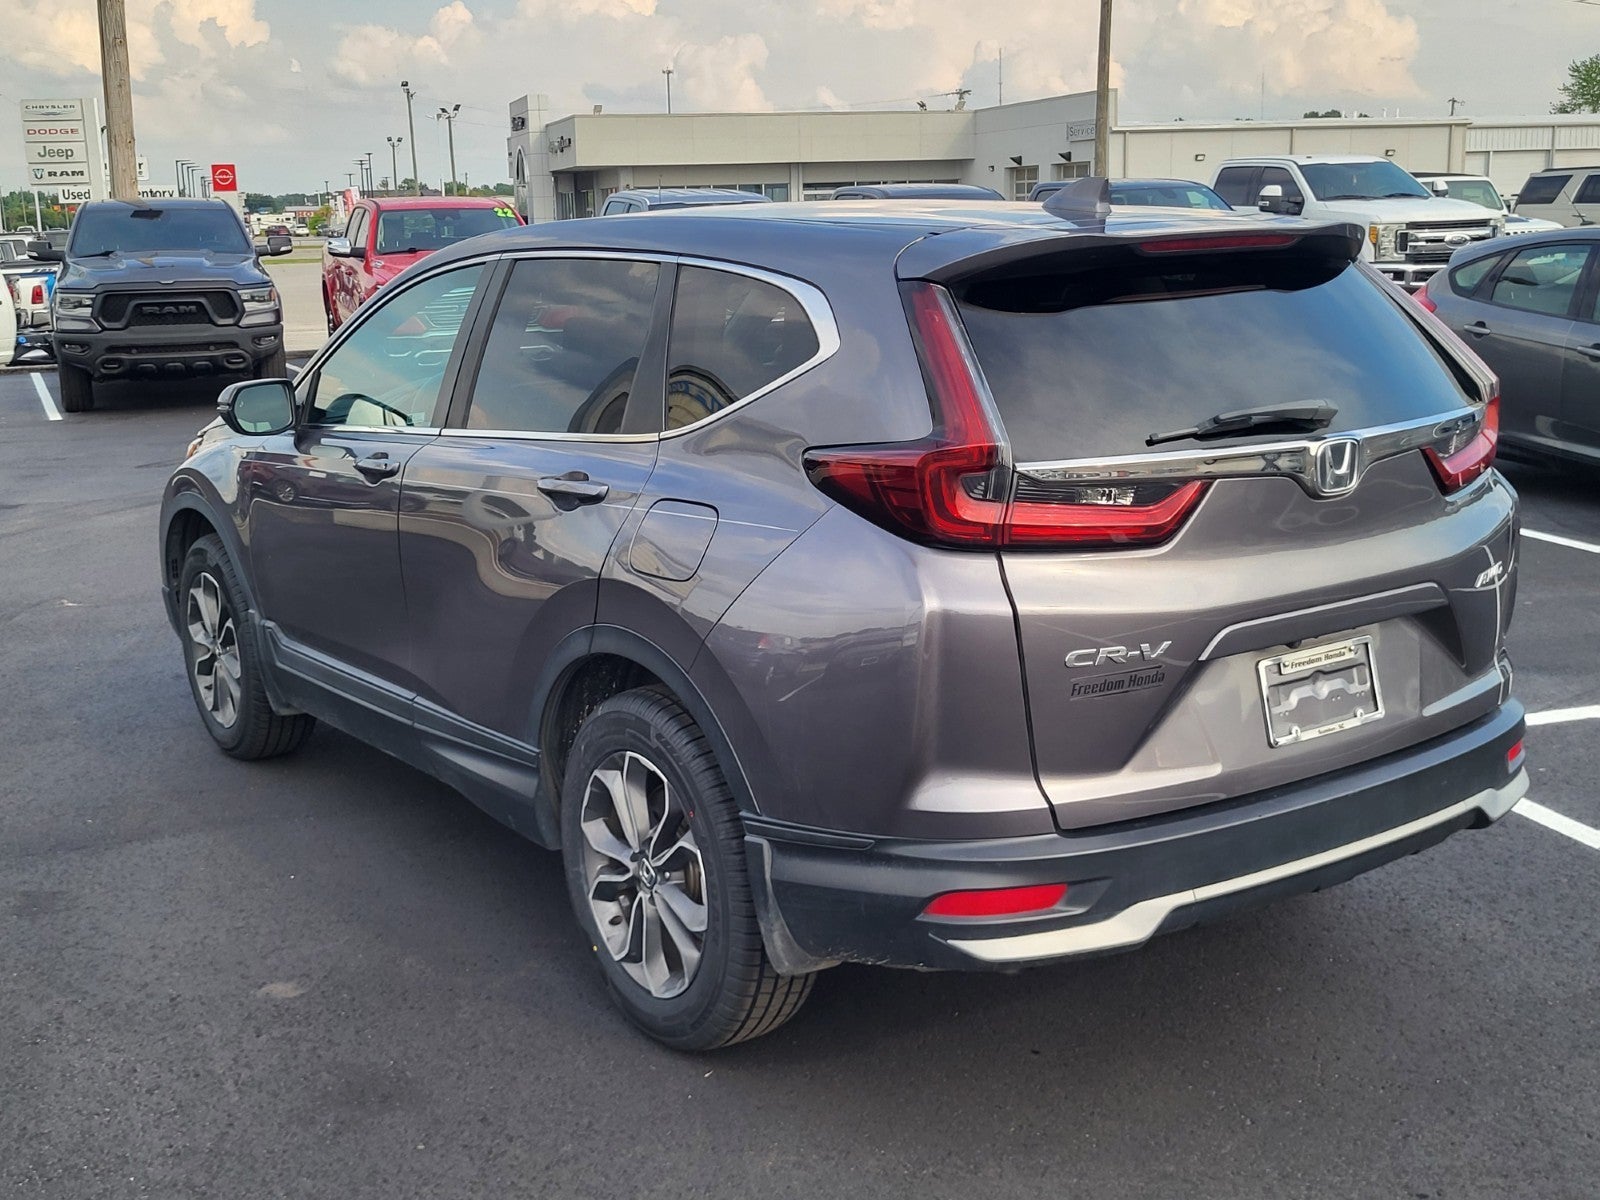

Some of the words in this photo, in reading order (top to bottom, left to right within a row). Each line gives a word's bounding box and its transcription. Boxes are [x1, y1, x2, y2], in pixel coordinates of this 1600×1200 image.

[1069, 126, 1095, 137] Service
[37, 145, 74, 160] Jeep
[62, 189, 91, 200] Used
[493, 207, 515, 218] 22
[142, 305, 197, 314] RAM
[1064, 640, 1172, 668] CR-V
[1290, 656, 1322, 669] Freedom
[1324, 651, 1346, 661] Honda
[1070, 679, 1125, 697] Freedom
[1128, 670, 1165, 688] Honda
